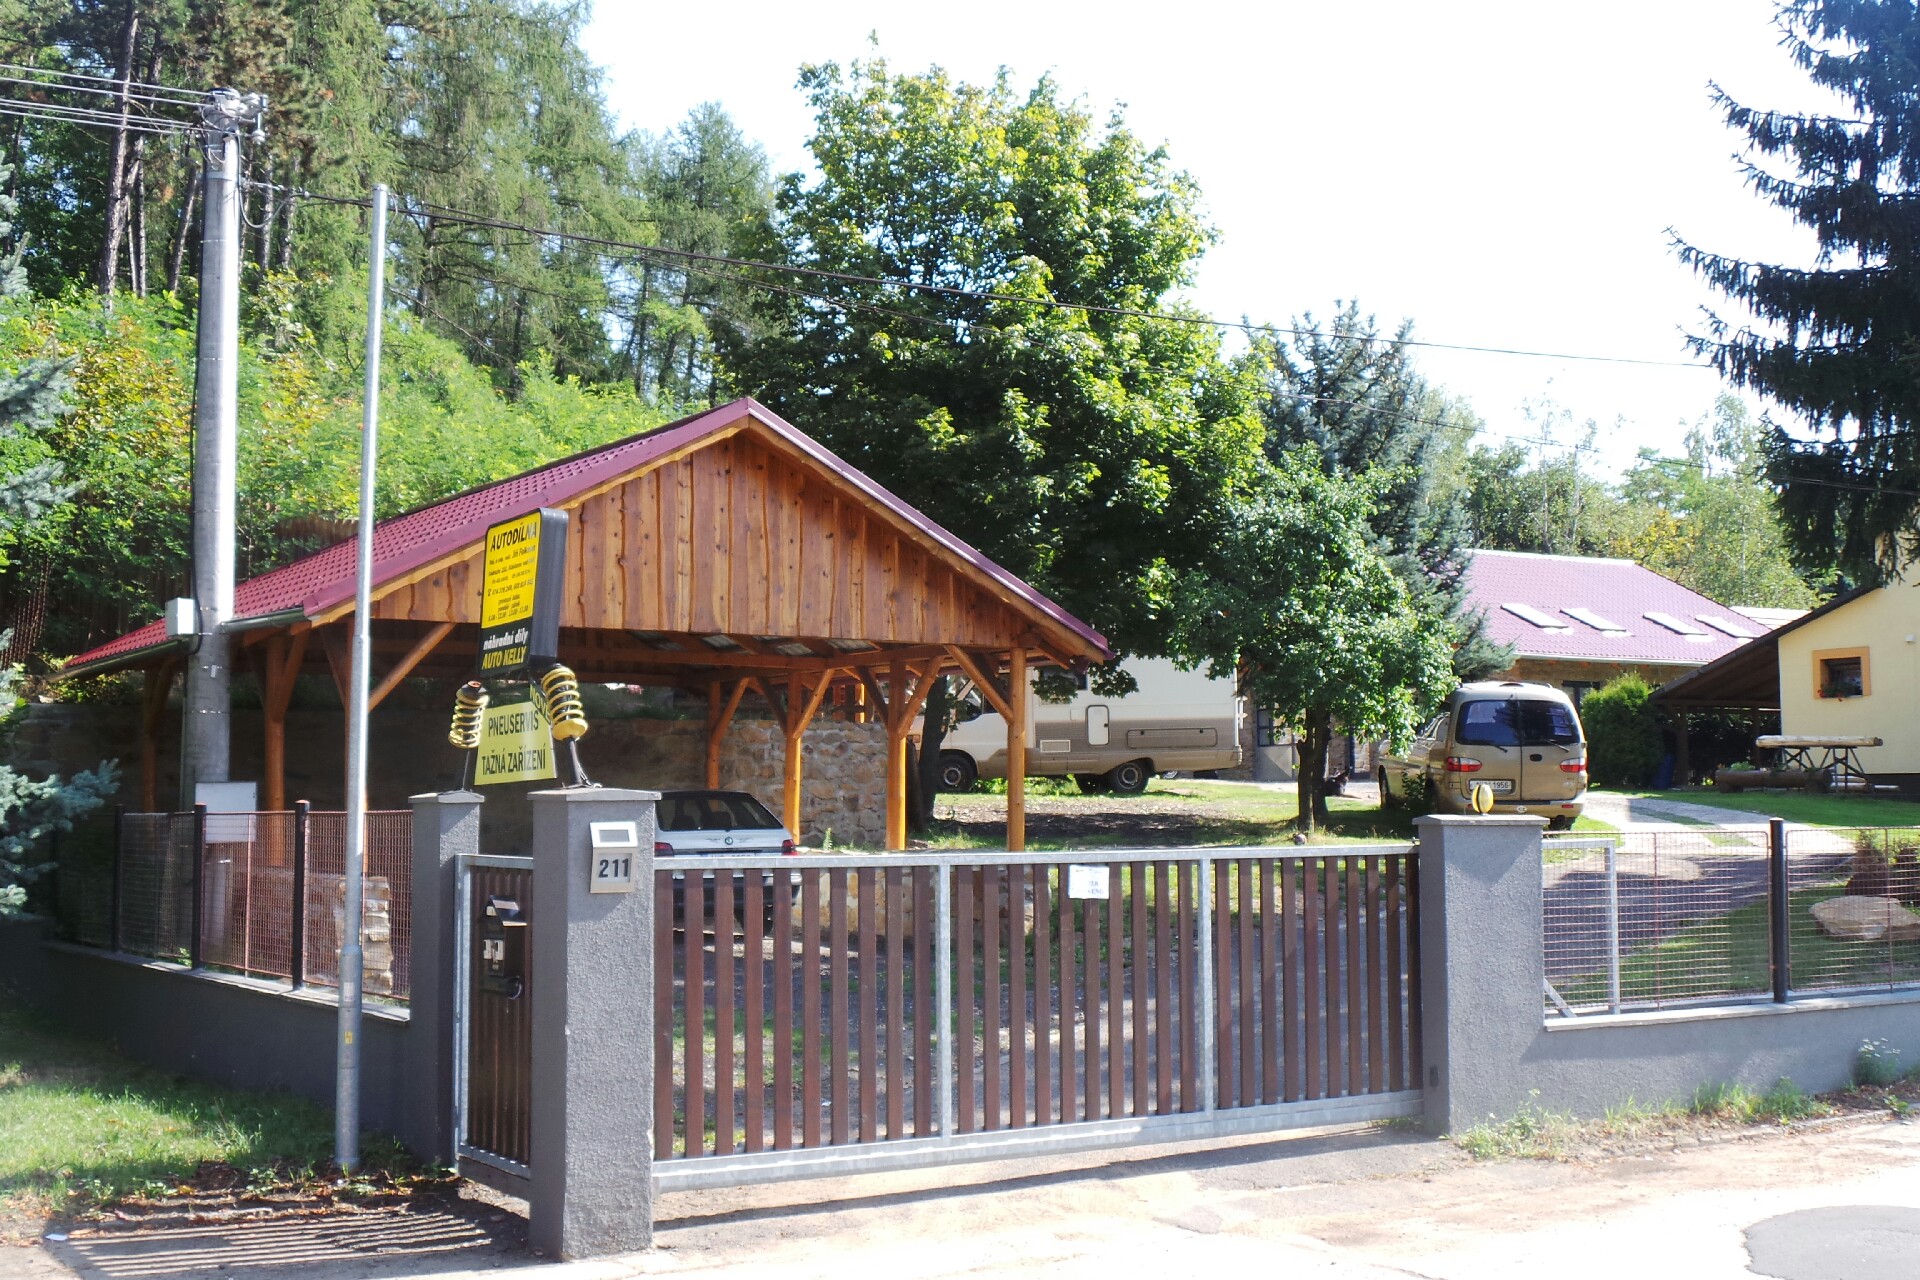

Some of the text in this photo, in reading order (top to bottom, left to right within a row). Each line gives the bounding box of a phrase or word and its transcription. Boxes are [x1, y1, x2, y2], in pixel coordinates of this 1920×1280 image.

[490, 522, 537, 552] AUTODÍLNA
[483, 627, 529, 650] náhradní díly
[482, 646, 527, 670] AUTO KELLY
[488, 710, 539, 737] PNEUSERVIS
[481, 743, 546, 775] TAŽNÁ ZAŘÍZENÍ
[598, 858, 629, 878] 211
